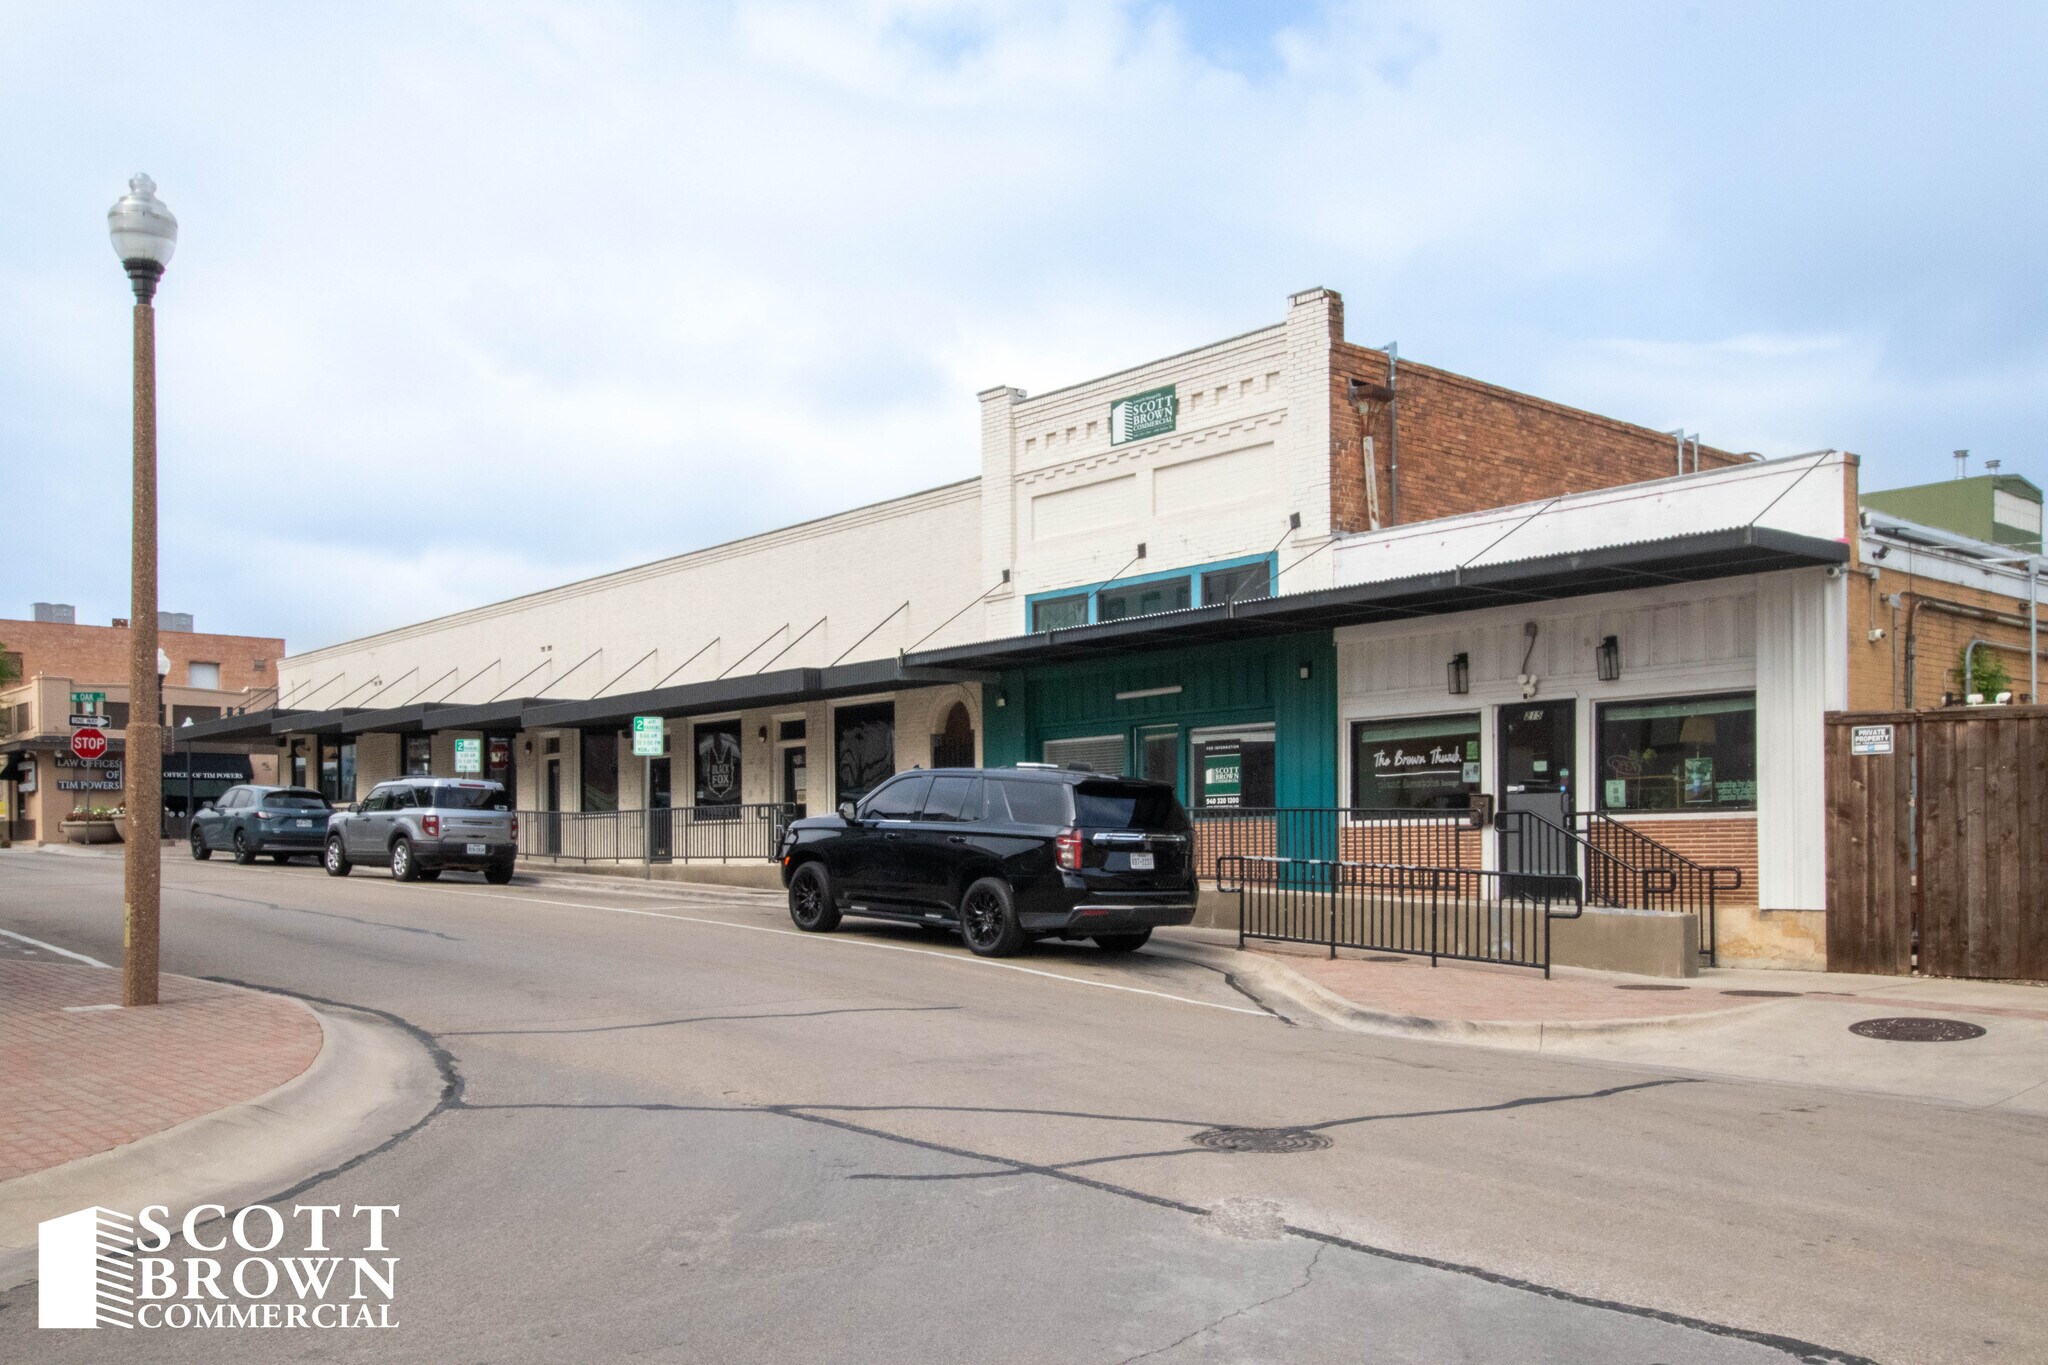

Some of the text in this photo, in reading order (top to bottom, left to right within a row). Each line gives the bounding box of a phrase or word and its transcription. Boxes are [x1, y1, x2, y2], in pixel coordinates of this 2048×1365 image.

[1133, 395, 1173, 415] SCOTT
[1133, 406, 1173, 425] BROWN
[1133, 416, 1173, 431] COMMERCIAL
[636, 720, 643, 730] 2
[74, 737, 105, 749] STOP
[458, 742, 464, 751] 2
[1373, 749, 1391, 767] The
[1394, 749, 1426, 766] Brown
[81, 760, 120, 768] OFFICES
[712, 764, 729, 774] BLACK
[106, 771, 120, 779] OF
[712, 774, 729, 784] FOX
[81, 781, 120, 789] POWERS
